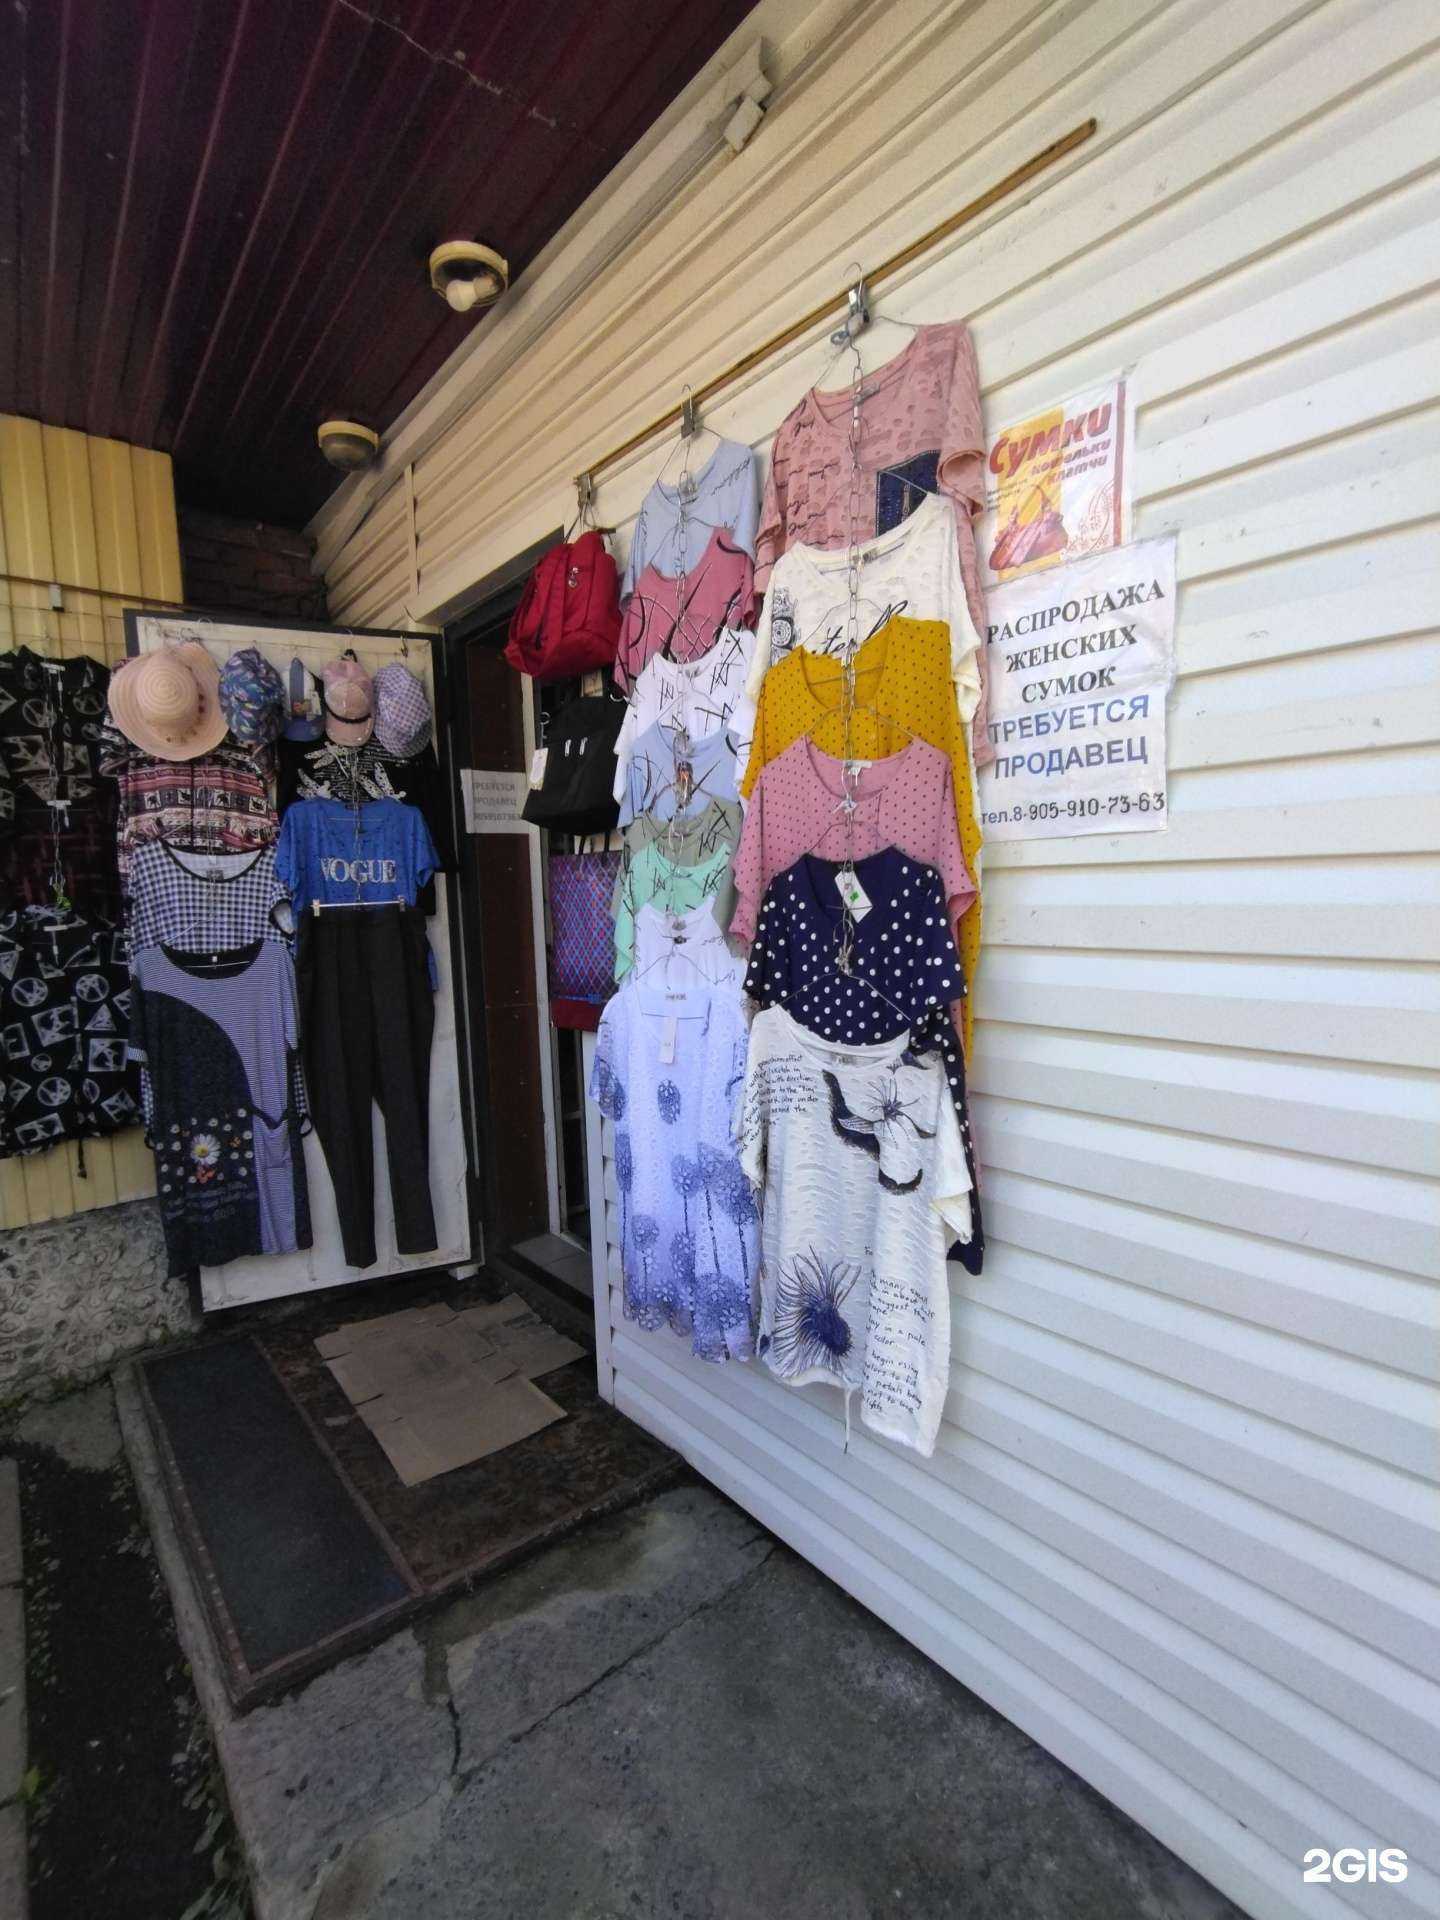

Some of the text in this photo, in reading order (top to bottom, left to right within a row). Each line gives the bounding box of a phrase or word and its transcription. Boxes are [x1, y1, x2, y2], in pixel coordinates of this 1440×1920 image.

[986, 579, 1165, 644] РАСПРОДАЖА
[1006, 624, 1139, 673] ЖЕНСКИХ
[1022, 666, 1116, 703] СУМОК
[988, 694, 1149, 744] ТРЕБУЕТСЯ
[994, 736, 1149, 779] ПРОДАВЕЦ
[320, 856, 396, 884] VOGUE
